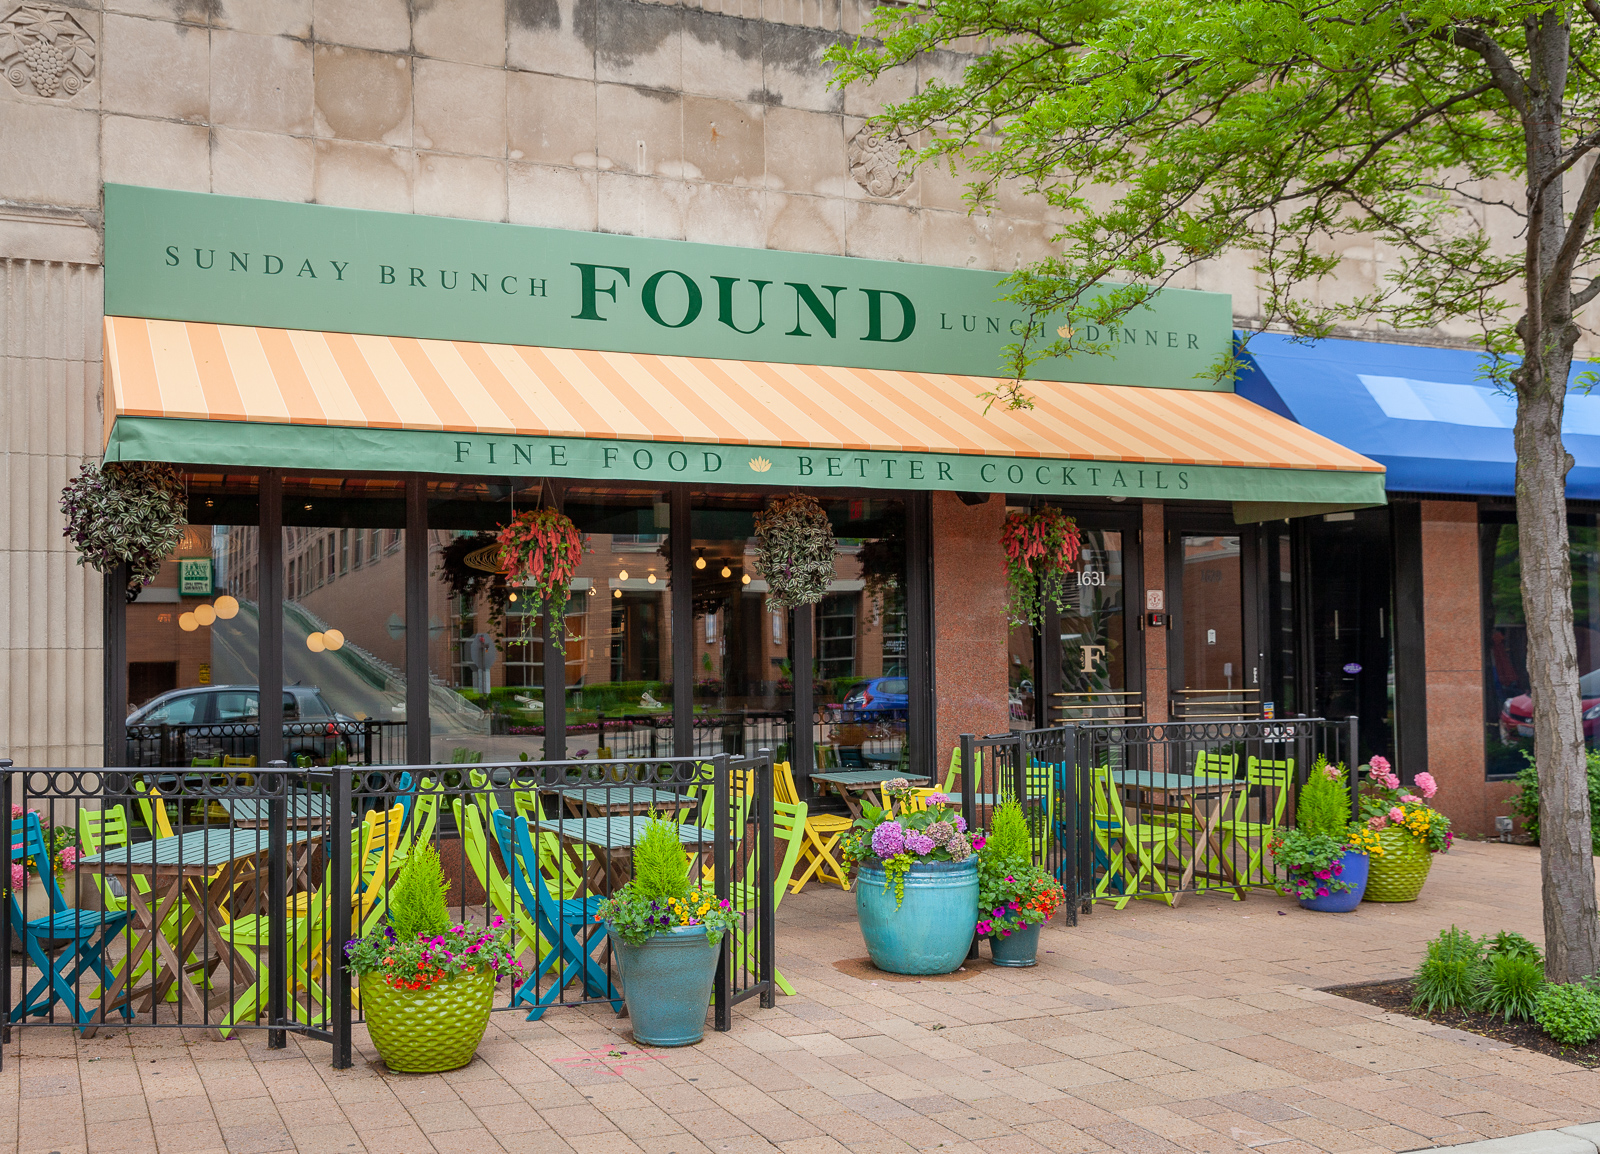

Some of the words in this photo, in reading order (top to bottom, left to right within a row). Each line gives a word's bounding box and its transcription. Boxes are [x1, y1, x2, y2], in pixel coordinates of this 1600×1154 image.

[164, 245, 349, 281] SUNDAY
[379, 265, 548, 297] BRUNCH
[570, 262, 916, 343] FOUND
[940, 312, 1046, 338] LUNCH
[1086, 325, 1199, 350] DINNER
[454, 441, 568, 467] FINE
[603, 447, 722, 473] FOOD
[797, 455, 955, 481] BETTER
[980, 462, 1190, 490] COCKTAILS
[1076, 571, 1106, 586] 1631
[1080, 645, 1106, 673] F
